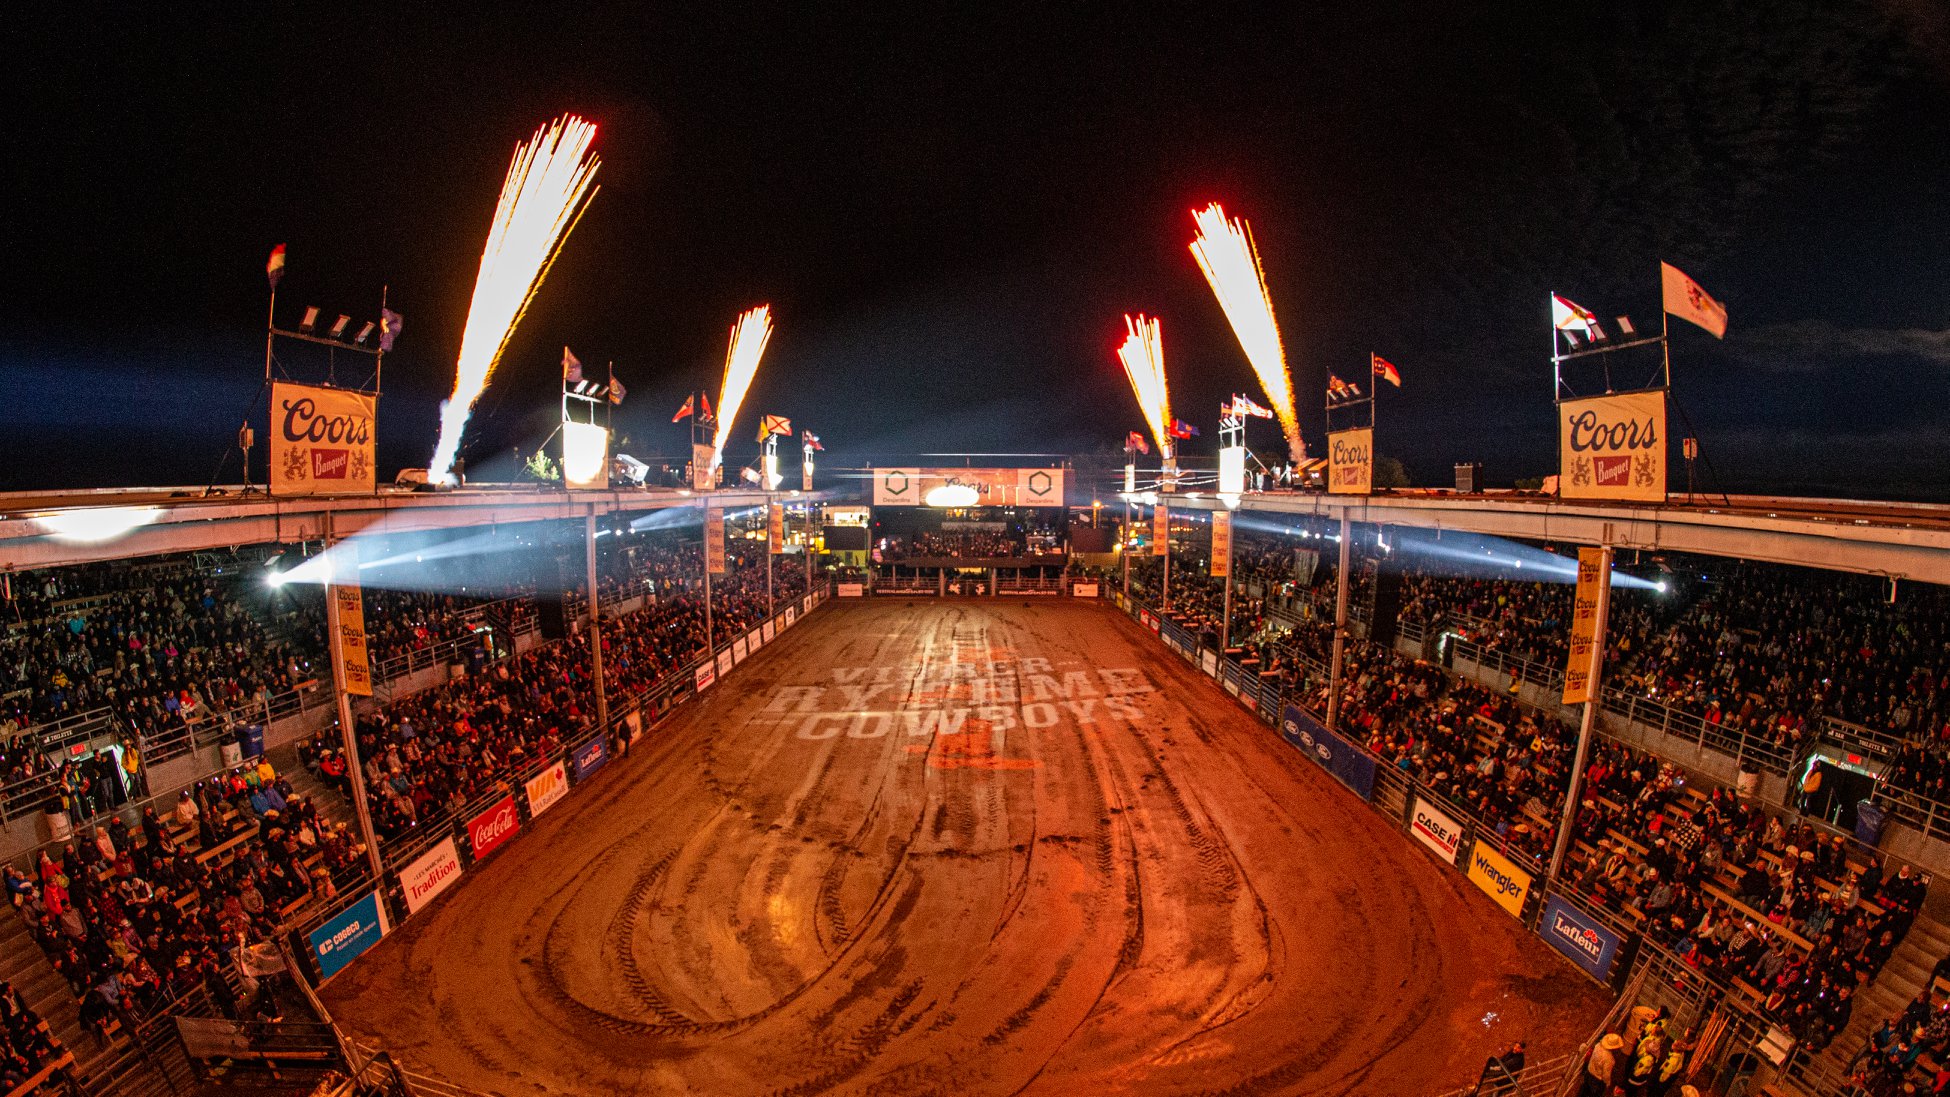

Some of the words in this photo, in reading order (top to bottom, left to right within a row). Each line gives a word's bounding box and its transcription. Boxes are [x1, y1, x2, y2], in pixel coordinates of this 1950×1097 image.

[283, 398, 369, 445] Coors
[1569, 410, 1657, 451] Coors
[1333, 440, 1368, 465] Coors
[315, 453, 346, 477] Banquet
[1598, 459, 1629, 483] Banquet
[1580, 560, 1600, 572] Coors
[339, 589, 360, 600] Coors
[1576, 598, 1597, 610] Coors
[342, 624, 363, 637] Coors
[1572, 632, 1592, 645] Coors
[346, 660, 367, 673] Coors
[1568, 669, 1588, 681] Coors
[796, 696, 1146, 740] COWBOYS
[50, 730, 73, 741] TOILETTE
[1859, 740, 1880, 751] TOILETTE
[529, 771, 556, 802] VIA
[475, 805, 513, 850] Coca-Cola
[1417, 813, 1447, 840] CASE
[409, 860, 456, 899] Tradition
[416, 871, 424, 880] LES
[1476, 852, 1522, 898] Wrangler
[1555, 917, 1600, 956] Lafleur
